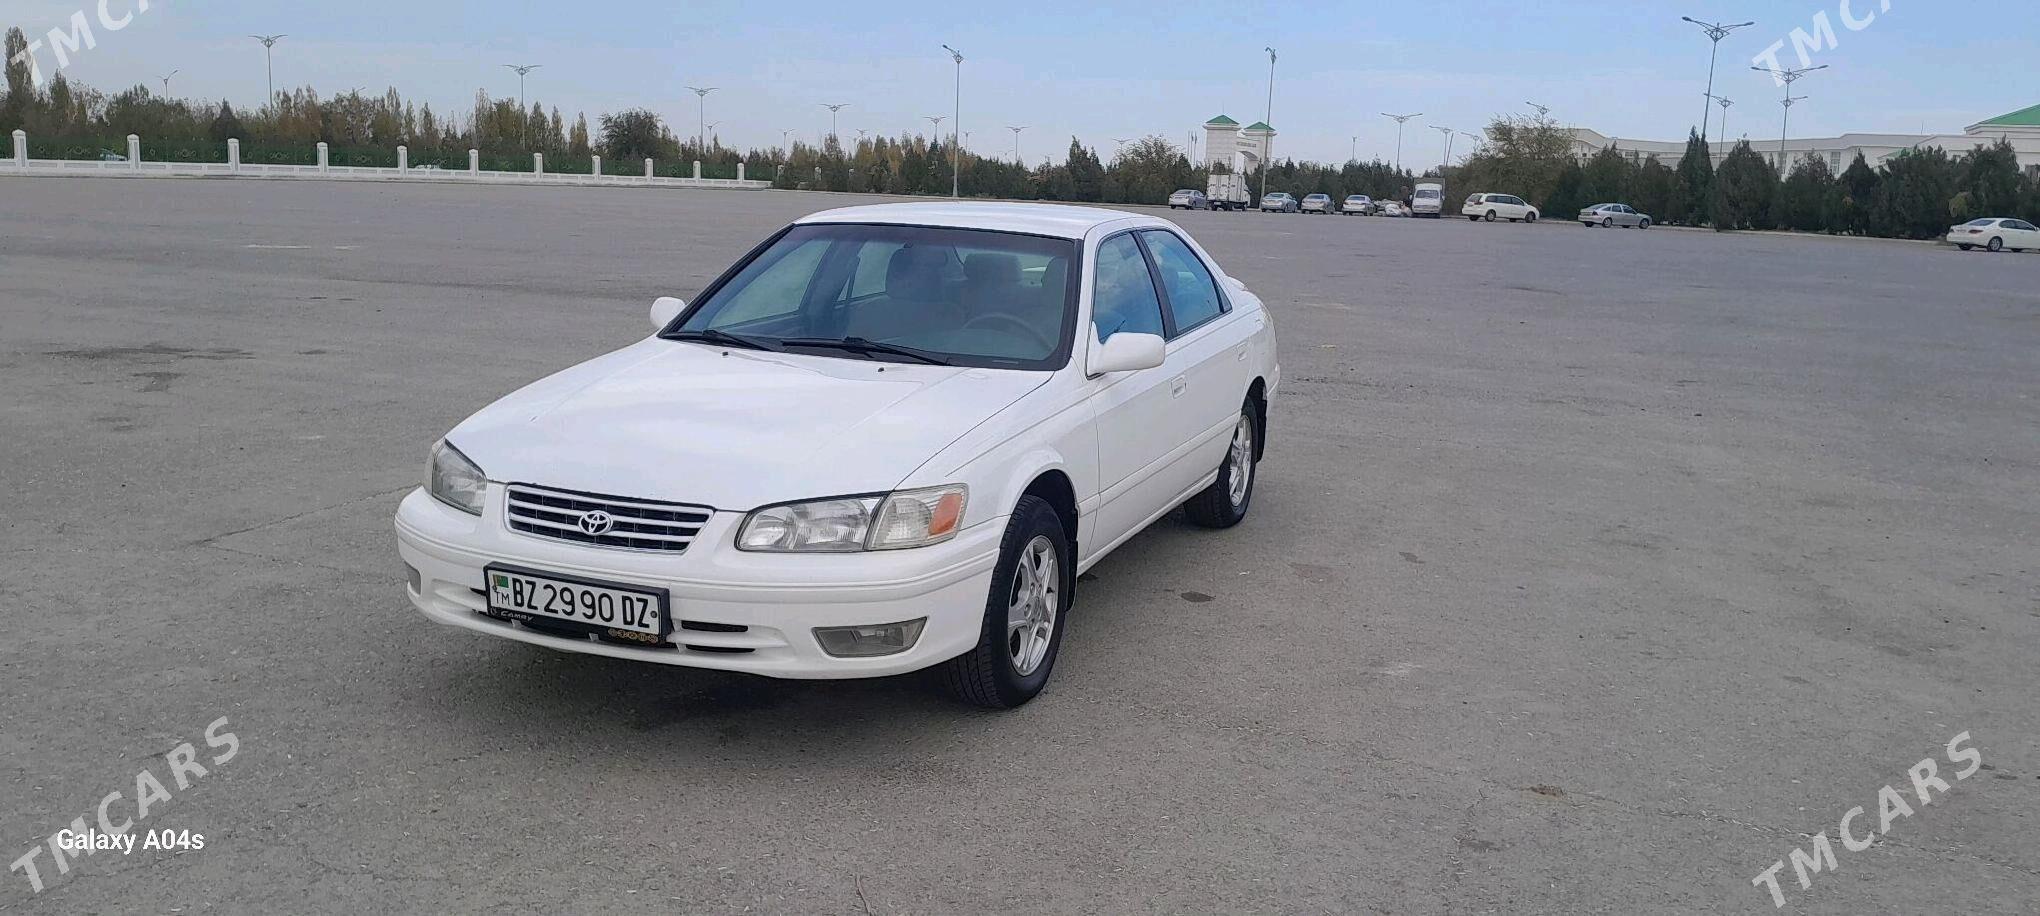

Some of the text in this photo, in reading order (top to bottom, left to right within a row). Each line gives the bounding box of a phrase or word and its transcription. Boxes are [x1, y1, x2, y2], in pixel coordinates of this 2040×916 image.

[495, 591, 510, 606] TM
[512, 577, 538, 611] BZ
[621, 595, 650, 628] DZ
